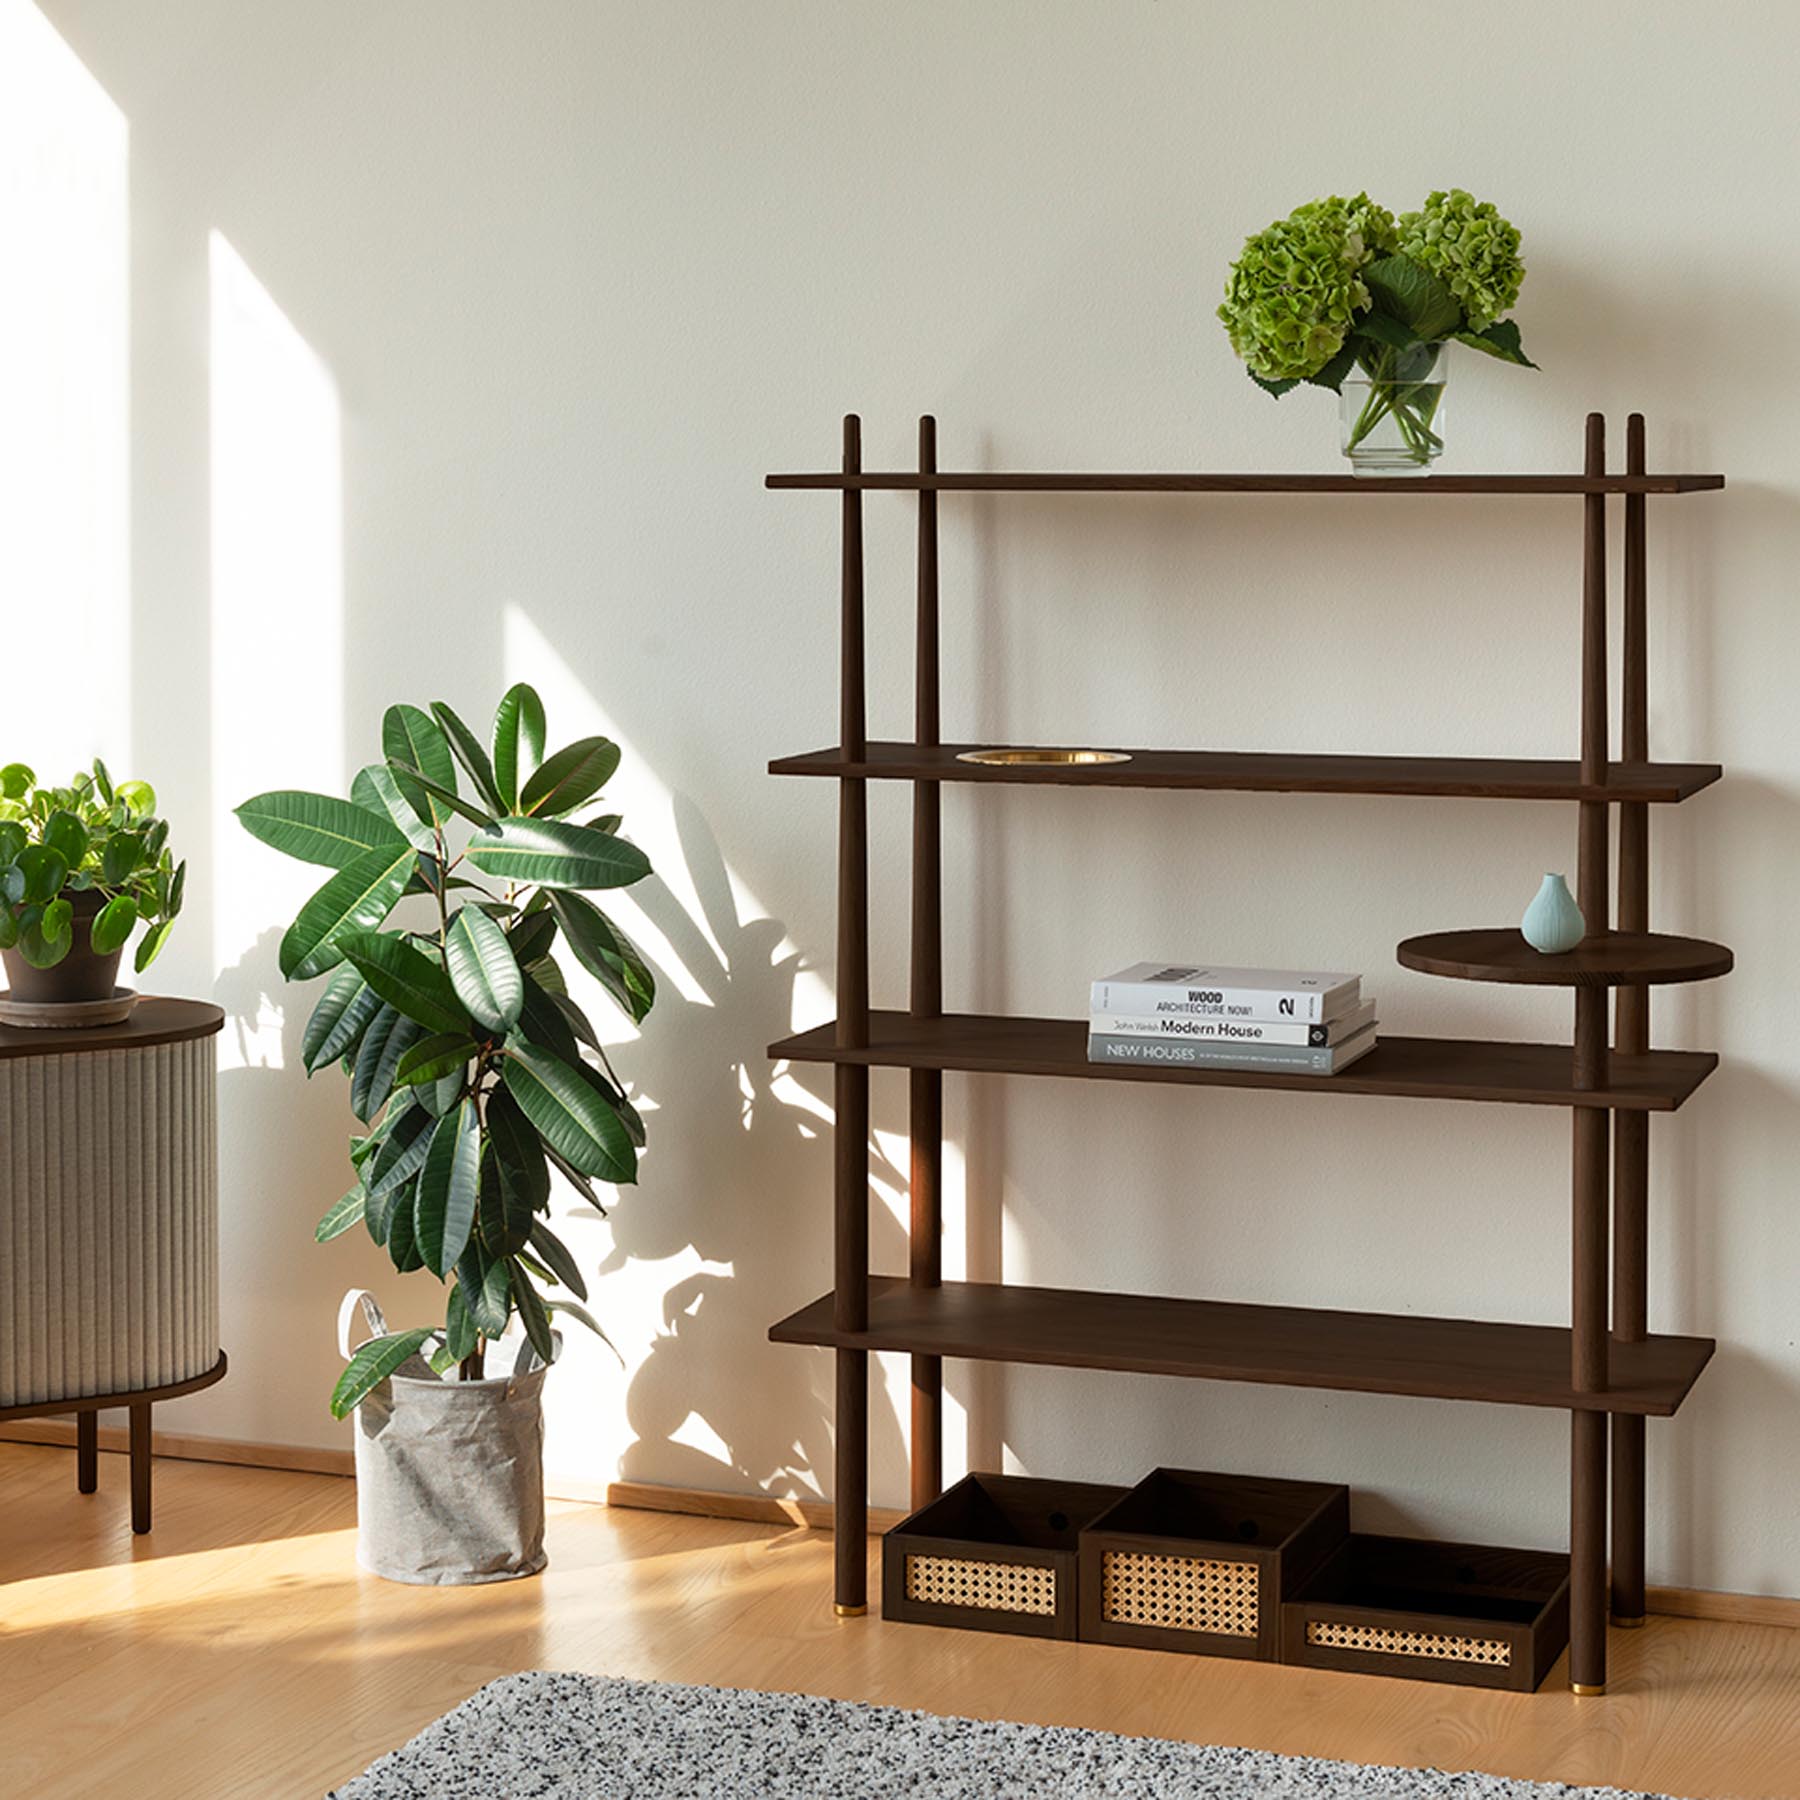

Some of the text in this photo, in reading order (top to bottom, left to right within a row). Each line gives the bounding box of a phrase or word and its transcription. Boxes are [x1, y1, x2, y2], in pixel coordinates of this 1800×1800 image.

[1188, 991, 1223, 1003] WOOD
[1156, 1002, 1224, 1015] ARCHITECTURE
[1278, 998, 1295, 1016] 2
[1161, 1020, 1214, 1034] Modern
[1217, 1022, 1263, 1038] House
[1107, 1044, 1140, 1057] NEW
[1143, 1046, 1195, 1060] HOUSES
